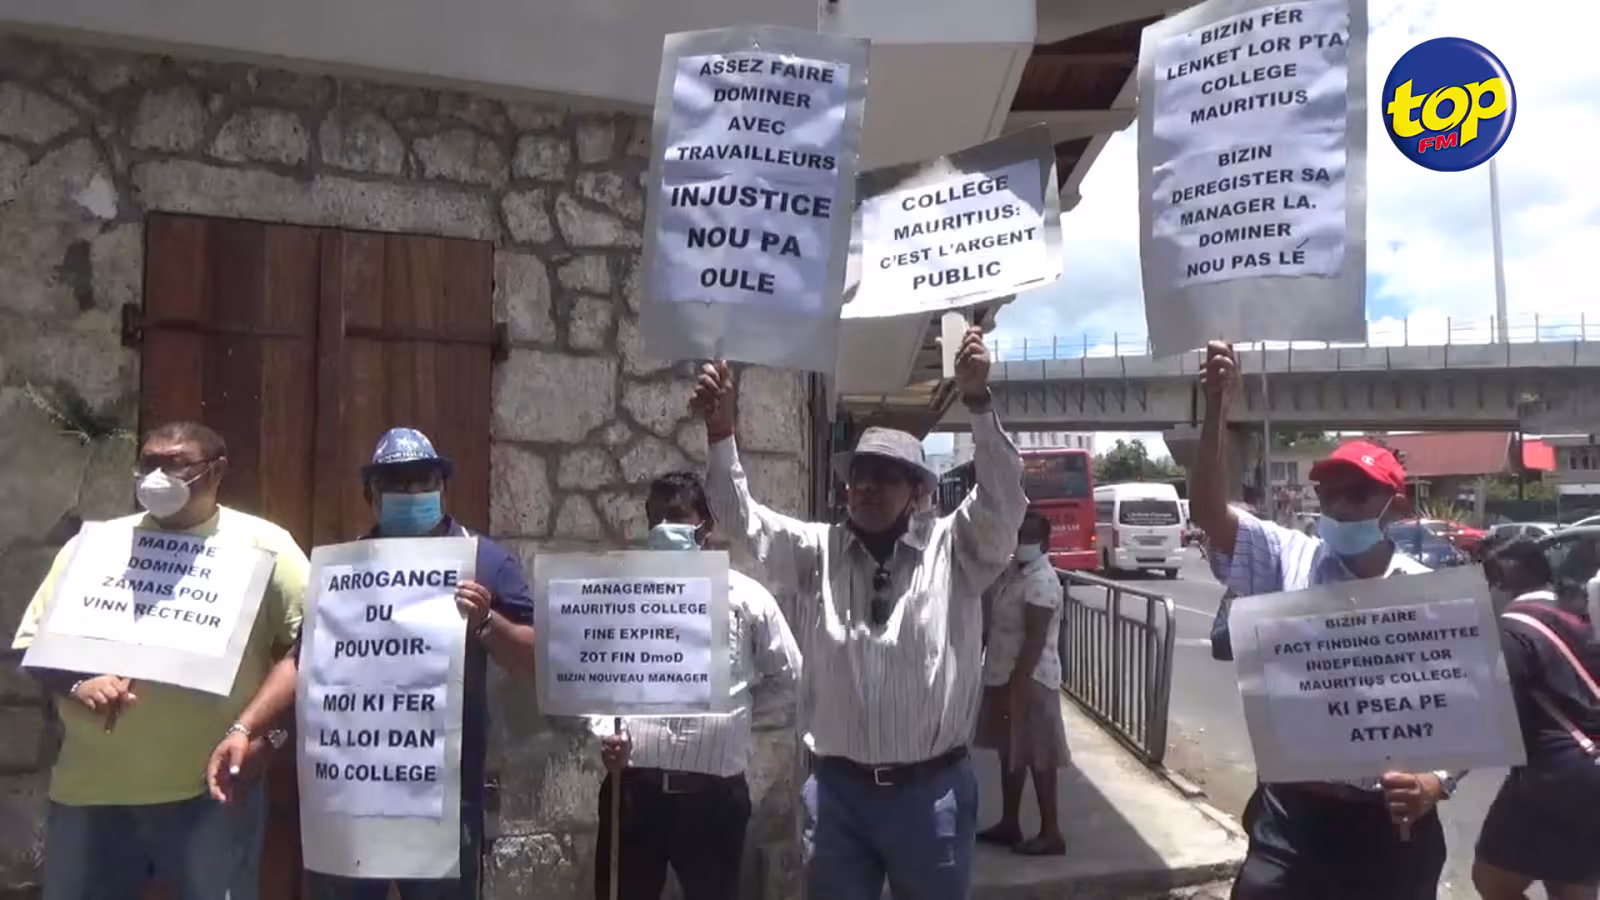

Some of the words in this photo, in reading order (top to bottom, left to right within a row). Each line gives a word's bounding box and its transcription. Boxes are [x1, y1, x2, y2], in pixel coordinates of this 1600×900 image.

[1200, 17, 1253, 45] BIZIN
[1167, 46, 1241, 81] LENKET
[1248, 38, 1290, 57] LOR
[1299, 32, 1343, 49] PTA
[699, 59, 763, 76] ASSEZ
[770, 61, 834, 83] FAIRE
[1201, 63, 1297, 95] COLLEGE
[714, 88, 810, 109] DOMINER
[728, 116, 785, 135] AVEC
[678, 145, 835, 170] TRAVAILLEURS
[1218, 145, 1272, 167] BIZIN
[902, 175, 1008, 211] COLLEGE
[1172, 169, 1293, 204] DEREGISTER
[1301, 168, 1330, 183] SA
[671, 186, 831, 219] INJUSTICE
[1180, 197, 1275, 226] MANAGER
[1284, 195, 1316, 209] LA.
[894, 204, 1021, 241] MAURITIUS:
[687, 227, 749, 249] NOU
[761, 232, 801, 258] PA
[1199, 223, 1291, 248] DOMINER
[913, 261, 1001, 290] PUBLIC
[1187, 258, 1224, 278] NOU
[1232, 252, 1271, 270] PAS
[700, 268, 775, 295] OULE
[138, 536, 217, 558] MADAME
[128, 556, 211, 580] DOMINER
[102, 576, 175, 596] ZAMAIS
[179, 587, 219, 604] POU
[329, 569, 458, 592] ARROGANCE
[582, 584, 686, 595] MANAGEMENT
[83, 596, 128, 612] VINN
[134, 604, 222, 628] RECTEUR
[366, 604, 393, 622] DU
[561, 604, 636, 615] MAURITIUS
[641, 604, 707, 614] COLLEGE
[1325, 615, 1367, 629] BIZIN
[1372, 611, 1417, 625] FAIRE
[584, 628, 615, 640] FINE
[620, 628, 680, 642] EXPIRE,
[1274, 642, 1312, 656] FACT
[1317, 635, 1380, 651] FINDING
[1385, 626, 1480, 644] COMMITTEE
[334, 637, 431, 658] POUVOIR-
[580, 652, 606, 663] ZOT
[612, 652, 635, 663] FIN
[641, 652, 684, 663] DmoD
[1306, 652, 1416, 672] INDEPENDANT
[1421, 649, 1452, 662] LOR
[557, 673, 585, 682] BIZIN
[589, 674, 644, 683] NOUVEAU
[648, 673, 708, 683] MANAGER
[1299, 674, 1385, 691] MAURITIUS
[323, 694, 356, 713] MOI
[363, 695, 384, 712] KI
[392, 694, 436, 711] FER
[1327, 701, 1350, 716] KI
[1357, 698, 1413, 715] PSEA
[1419, 694, 1448, 710] PE
[320, 729, 340, 747] LA
[347, 730, 379, 747] LOI
[388, 729, 435, 748] DAN
[1350, 723, 1433, 743] ATTAN?
[315, 763, 339, 780] MO
[345, 765, 436, 782] COLLEGE
